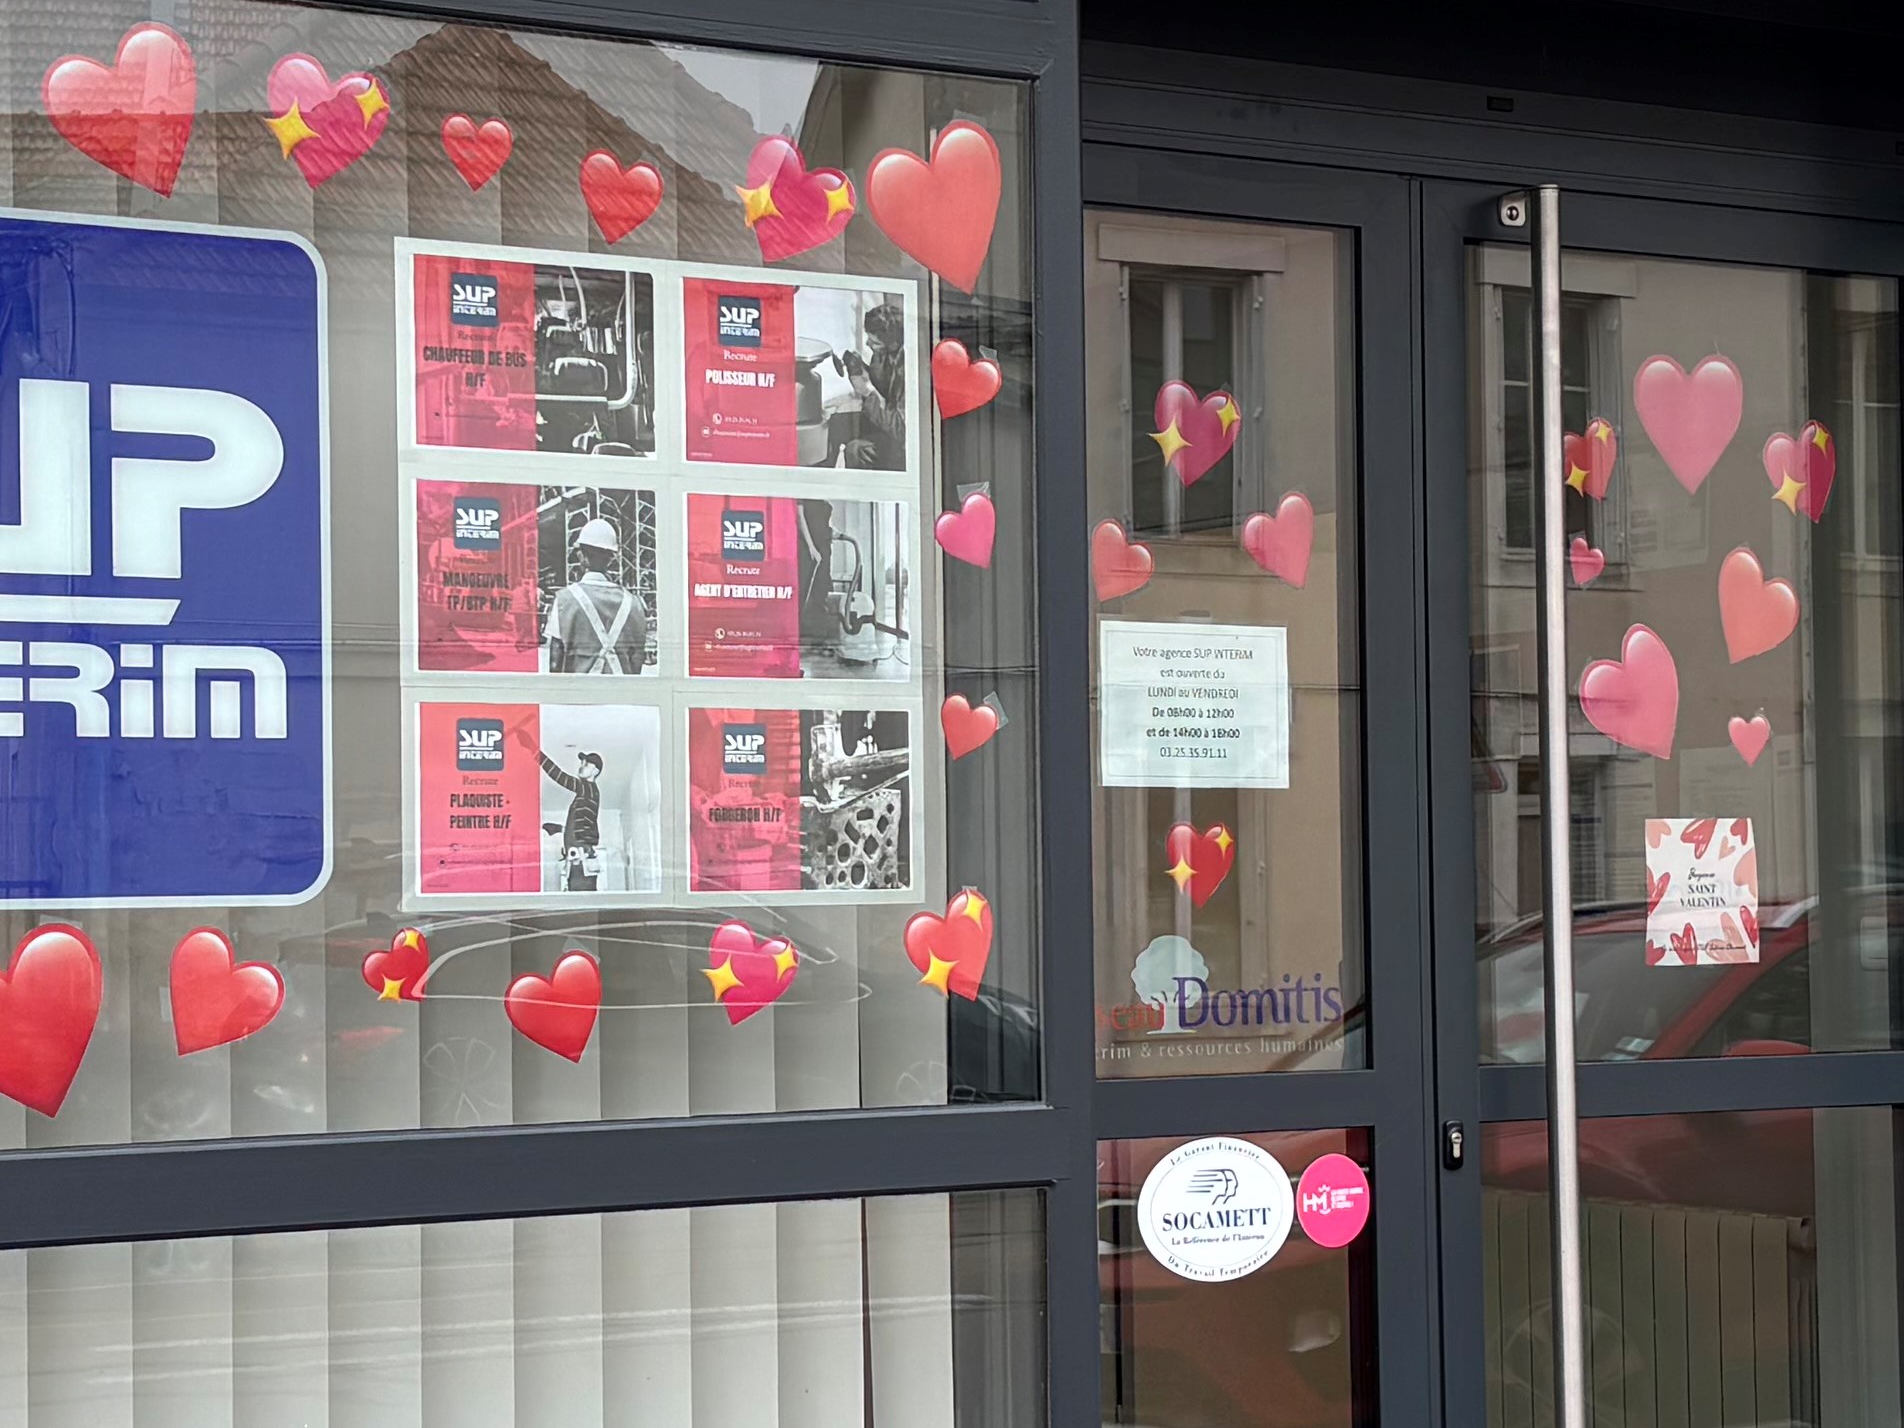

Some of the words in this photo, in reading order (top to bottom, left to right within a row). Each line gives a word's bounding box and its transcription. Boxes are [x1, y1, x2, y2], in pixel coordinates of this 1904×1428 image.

[453, 284, 496, 302] SUP
[720, 306, 759, 323] SUP
[423, 346, 484, 365] CHAUFFEUR
[489, 351, 503, 366] DE
[506, 352, 527, 367] BUS
[706, 369, 756, 387] POLISSEUR
[456, 508, 499, 525] SUP
[724, 521, 763, 537] SUP
[694, 583, 722, 597] AGENT
[1133, 646, 1157, 657] Votre
[1160, 647, 1192, 659] agence
[1194, 648, 1212, 659] SUP
[1160, 669, 1174, 678] est
[1176, 669, 1211, 679] ouverte
[1148, 687, 1176, 698] LUNDI
[1192, 687, 1238, 699] VENDREDI
[1152, 707, 1165, 717] De
[459, 730, 502, 746] SUP
[1146, 727, 1156, 737] et
[1159, 727, 1170, 737] de
[1173, 727, 1202, 738] 14h00
[725, 735, 765, 751] SUP
[450, 793, 503, 808] PLAQUISTE
[450, 815, 490, 829] PEINTRE
[1688, 884, 1716, 894] SAINT
[1680, 897, 1726, 907] VALENTIN
[1172, 973, 1342, 1028] Domitis
[1141, 1042, 1152, 1058] &
[1160, 1038, 1251, 1057] ressources
[1260, 1037, 1342, 1054] humaines
[1162, 1208, 1271, 1232] SOCAMETT
